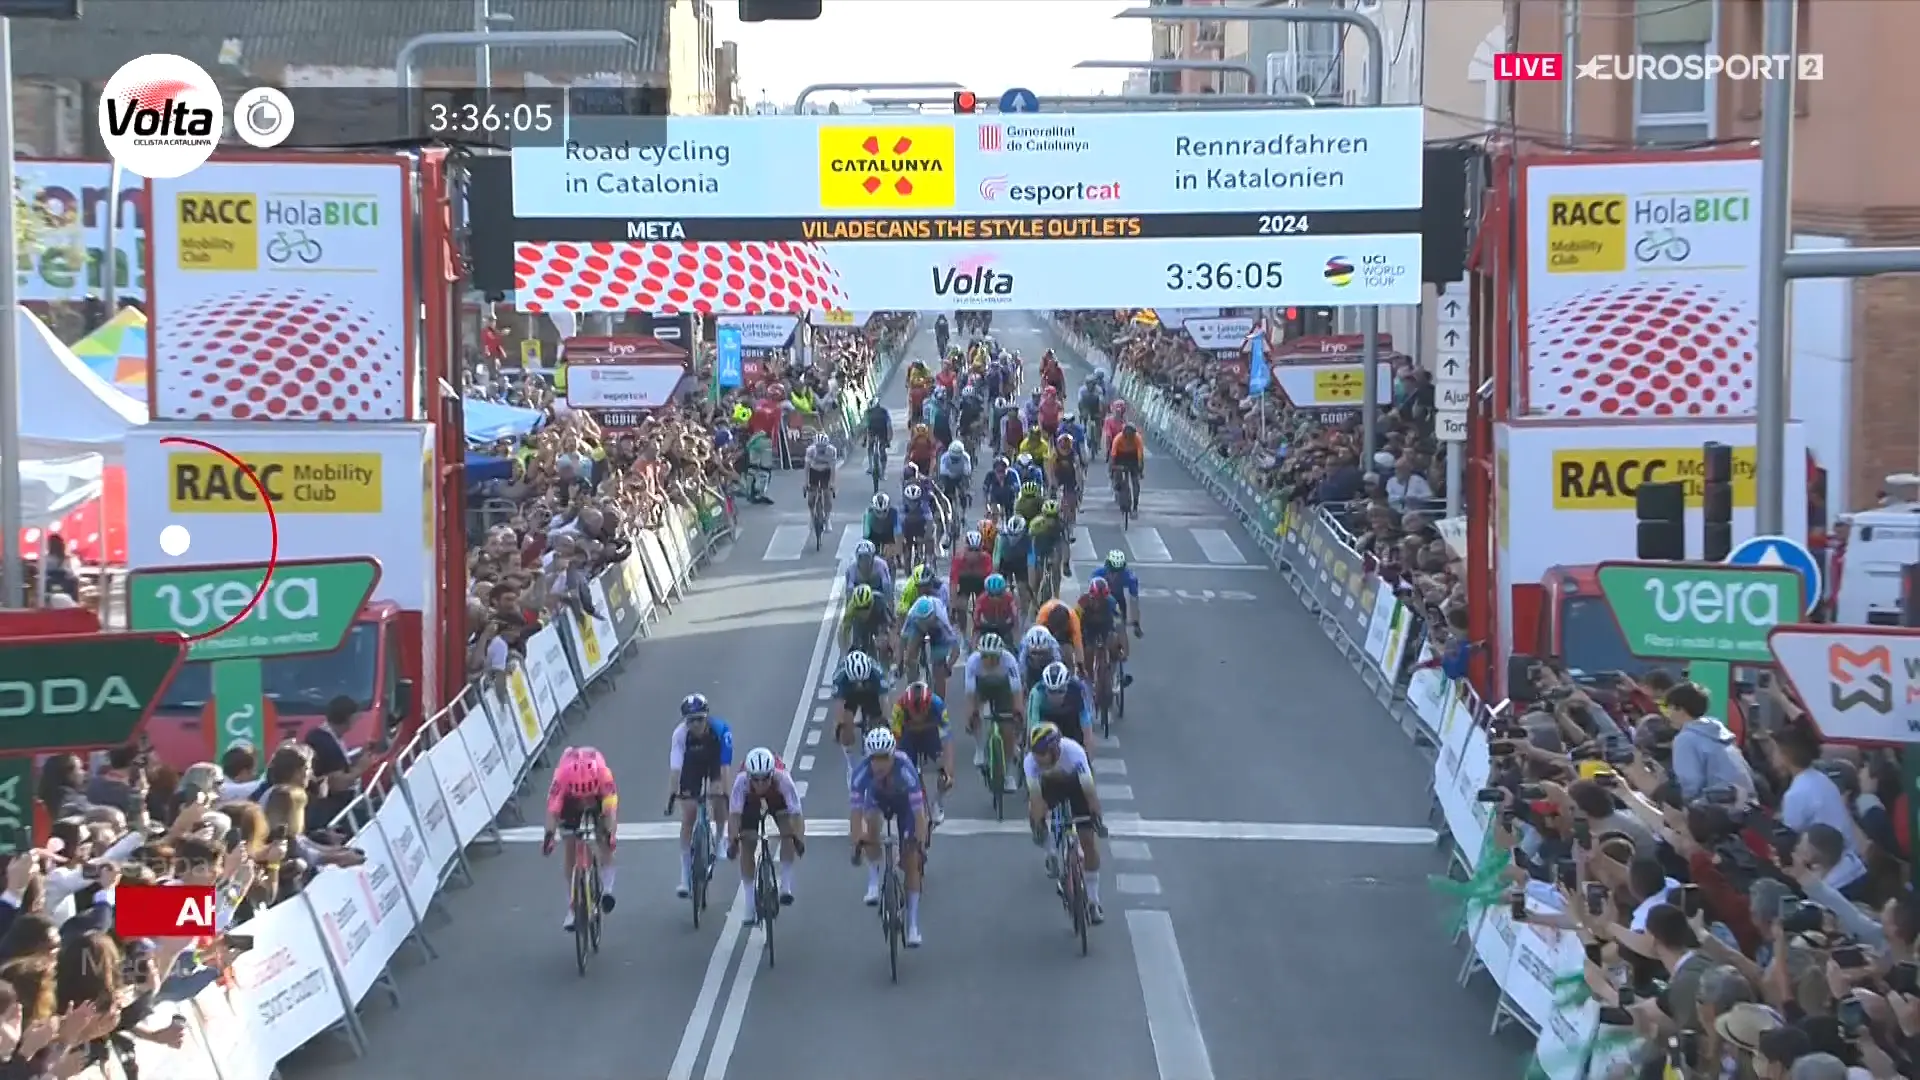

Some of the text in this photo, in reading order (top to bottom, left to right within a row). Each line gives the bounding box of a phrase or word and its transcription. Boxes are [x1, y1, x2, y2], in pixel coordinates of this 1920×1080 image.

[1007, 125, 1076, 137] Generalitat
[565, 140, 731, 167] Road cycling
[1007, 139, 1090, 153] de Catalunya
[1175, 133, 1368, 157] Rennradfahren
[830, 158, 943, 173] CATALUNYA
[565, 172, 719, 194] in Catalonia
[1174, 166, 1344, 190] in Katalonien
[1009, 181, 1120, 205] esportcat
[181, 198, 378, 226] RACC HolaBICI
[1551, 197, 1749, 226] RACC HolaBICI
[626, 221, 686, 240] META
[801, 217, 1142, 240] VILADECANS THE STYLE OUTLETS
[1257, 215, 1309, 234] 2024
[1362, 255, 1387, 265] UCI
[1362, 265, 1405, 276] WORLD
[932, 265, 1014, 295] Volta
[1165, 261, 1284, 291] 3:36:05
[1364, 276, 1395, 288] TOUR
[175, 463, 284, 501] RACC
[293, 463, 373, 486] Mobility
[293, 483, 337, 501] Club
[154, 576, 319, 627] vera
[1644, 577, 1779, 626] vera
